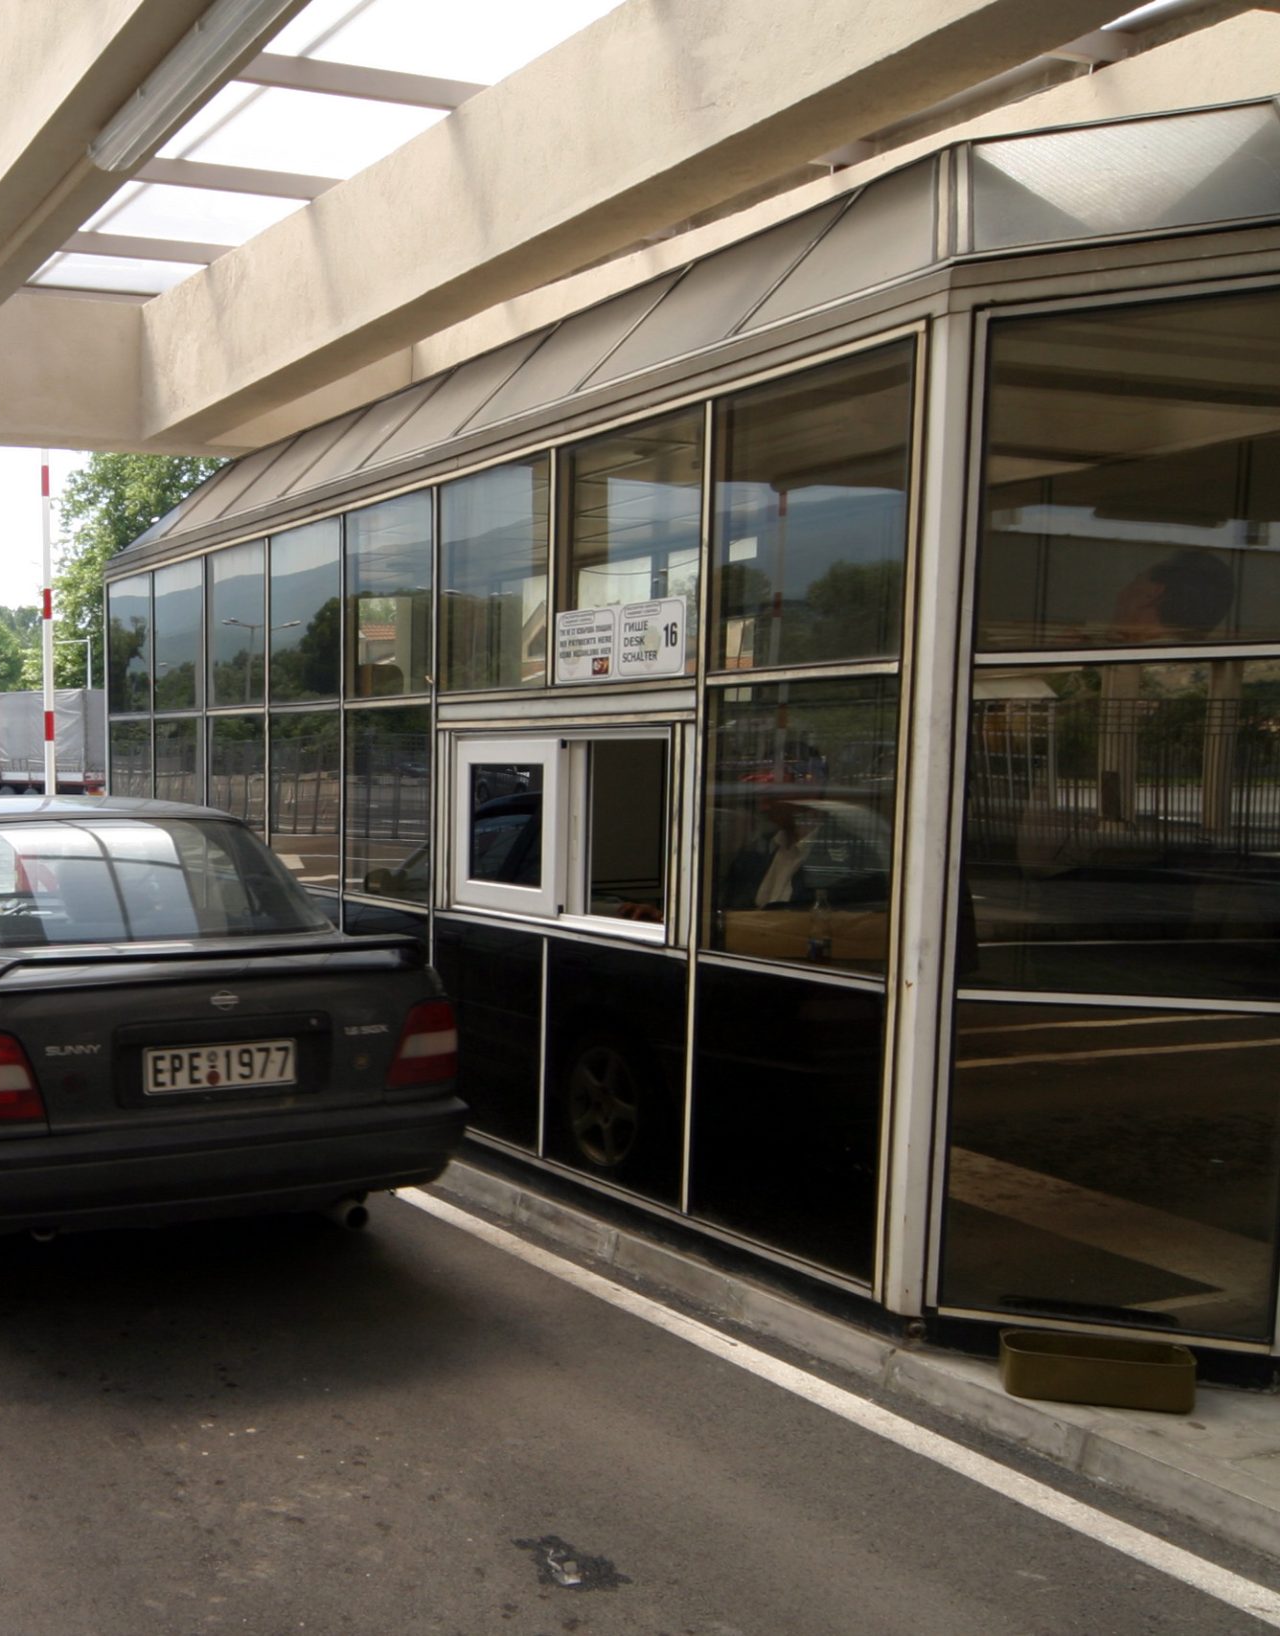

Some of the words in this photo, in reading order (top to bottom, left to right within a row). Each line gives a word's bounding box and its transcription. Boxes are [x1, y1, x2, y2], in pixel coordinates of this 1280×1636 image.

[624, 620, 648, 633] ГИШЕ
[663, 621, 678, 648] 16
[624, 636, 645, 648] DESK
[622, 650, 658, 663] SCHALTER
[44, 1043, 102, 1057] SUNNY
[152, 1051, 202, 1088] EPE
[224, 1046, 291, 1082] 1977
